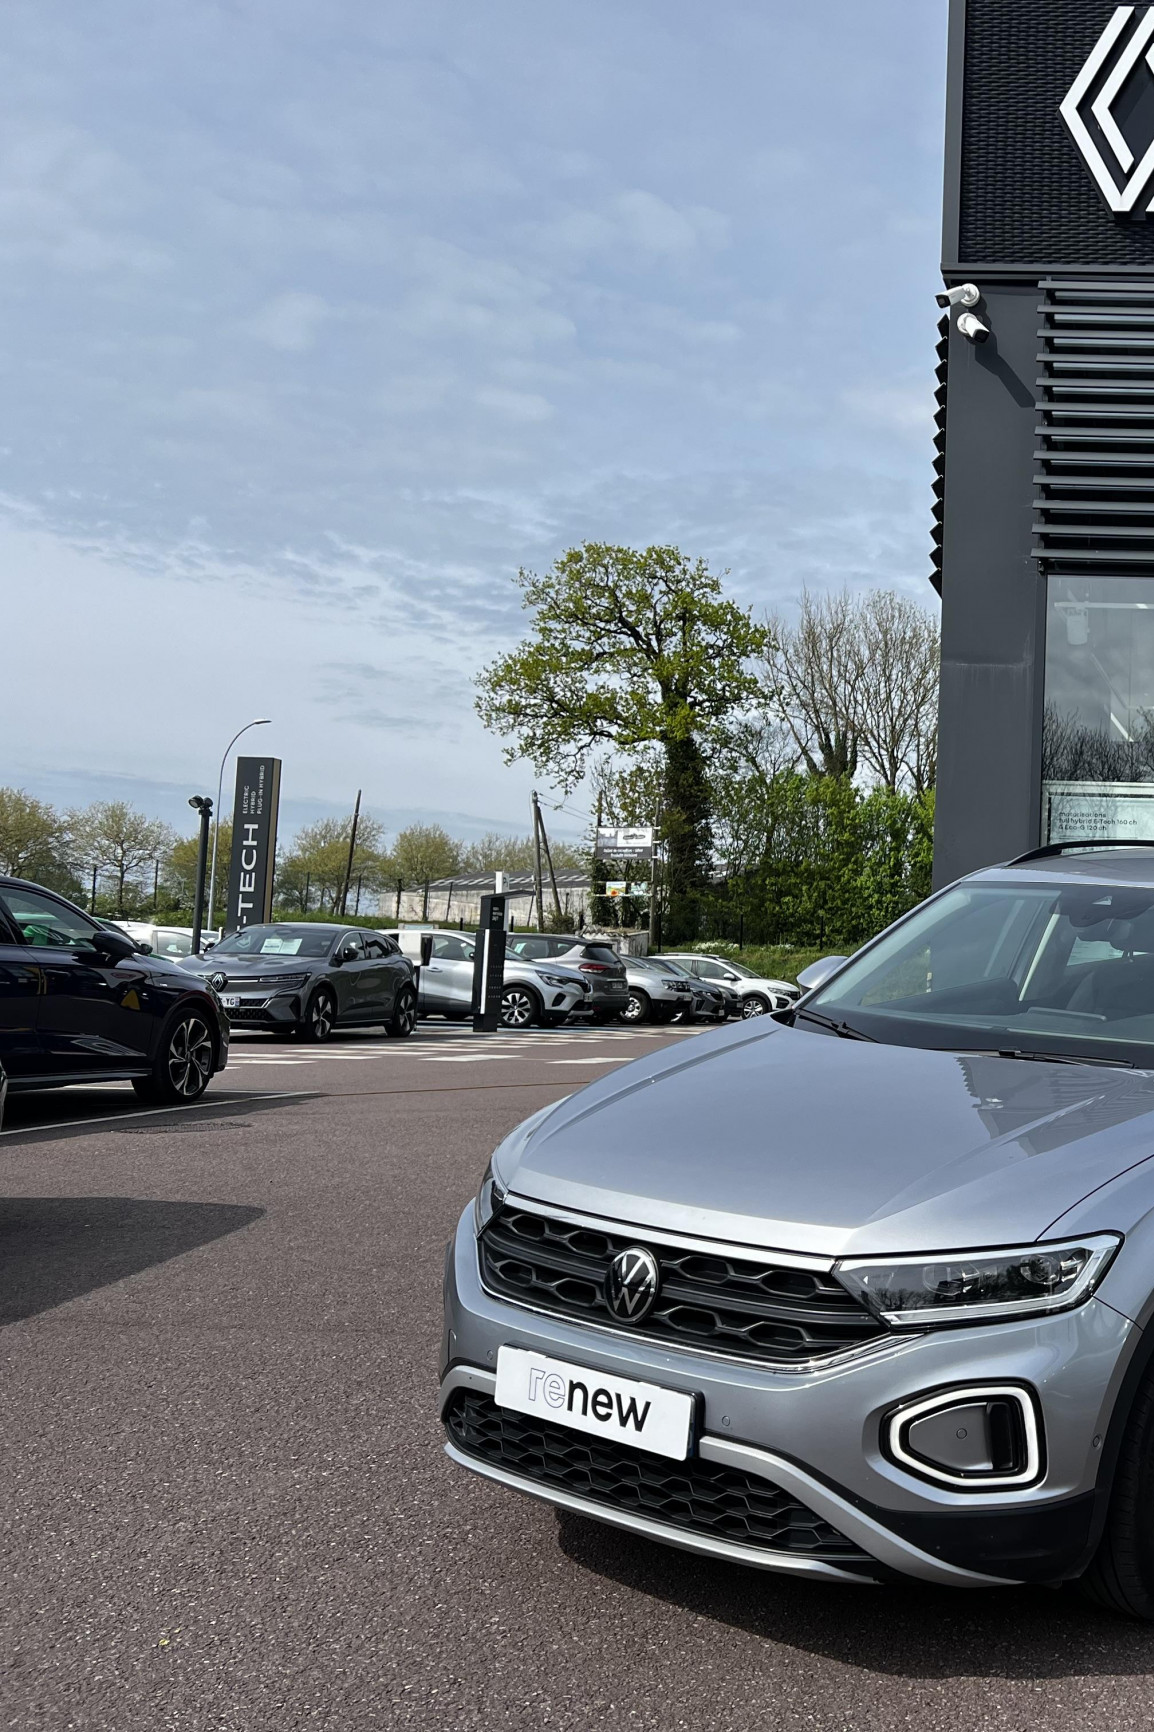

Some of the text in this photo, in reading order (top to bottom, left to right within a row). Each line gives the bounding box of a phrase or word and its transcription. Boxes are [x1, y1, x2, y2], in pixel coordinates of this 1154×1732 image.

[242, 785, 250, 814] ELECTRIC
[236, 823, 259, 932] -TECH
[528, 1367, 652, 1433] renew
